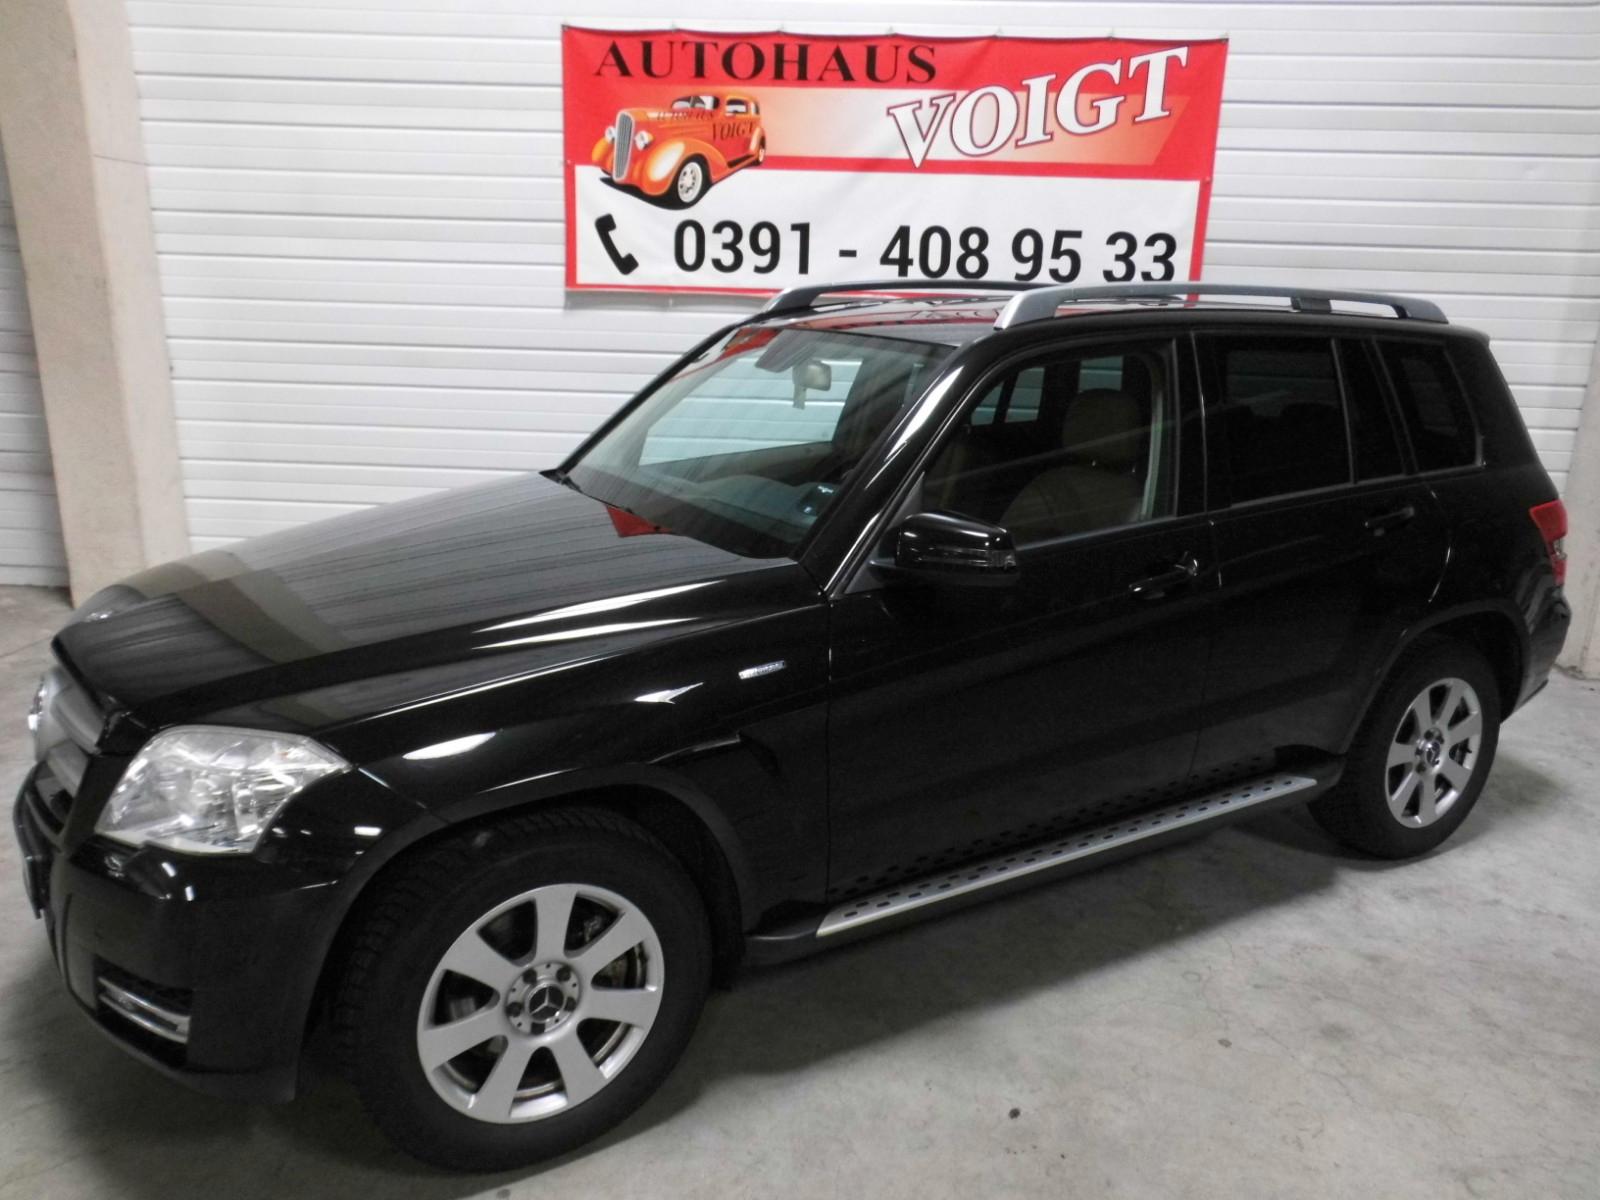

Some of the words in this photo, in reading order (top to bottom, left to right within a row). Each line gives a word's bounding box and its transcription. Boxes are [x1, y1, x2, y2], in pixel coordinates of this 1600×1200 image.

[592, 39, 936, 84] AUTOHAUS
[886, 46, 1190, 168] VOIGT
[673, 219, 811, 275] 0391
[878, 225, 990, 280] 408
[1011, 228, 1083, 283] 95
[1102, 231, 1177, 282] 33
